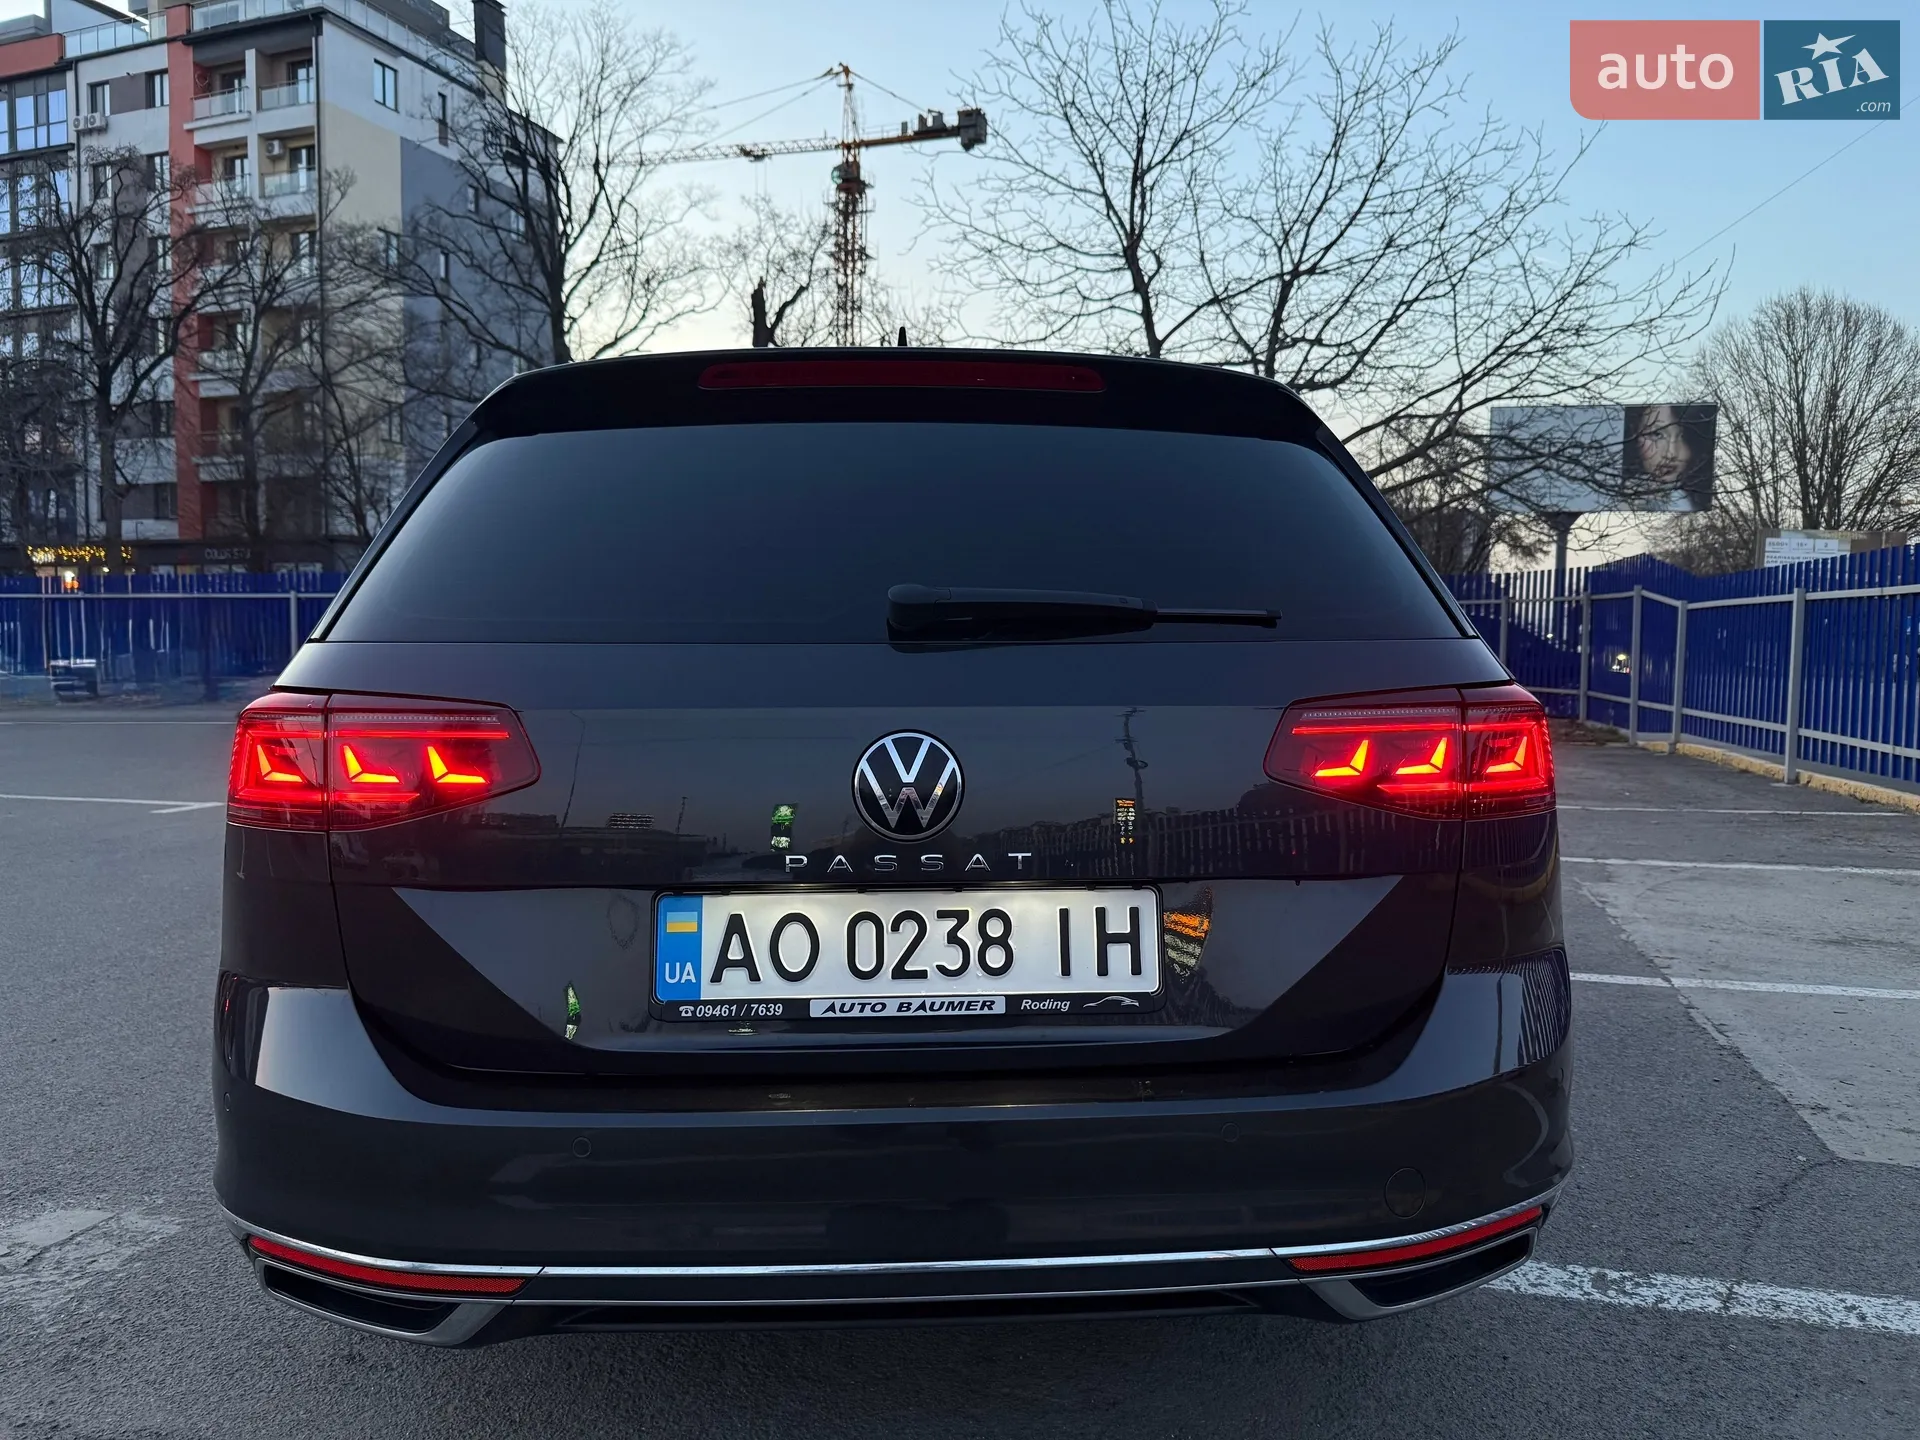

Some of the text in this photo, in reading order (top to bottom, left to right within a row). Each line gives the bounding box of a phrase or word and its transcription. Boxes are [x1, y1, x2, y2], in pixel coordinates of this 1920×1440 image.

[785, 852, 1032, 874] PASSAT
[710, 906, 1142, 984] AO 0238 IH
[664, 963, 697, 984] UA
[696, 1004, 736, 1018] 09461
[750, 1003, 783, 1016] 7639
[820, 999, 996, 1015] AUTO BAUMER
[1020, 999, 1070, 1012] Roding
